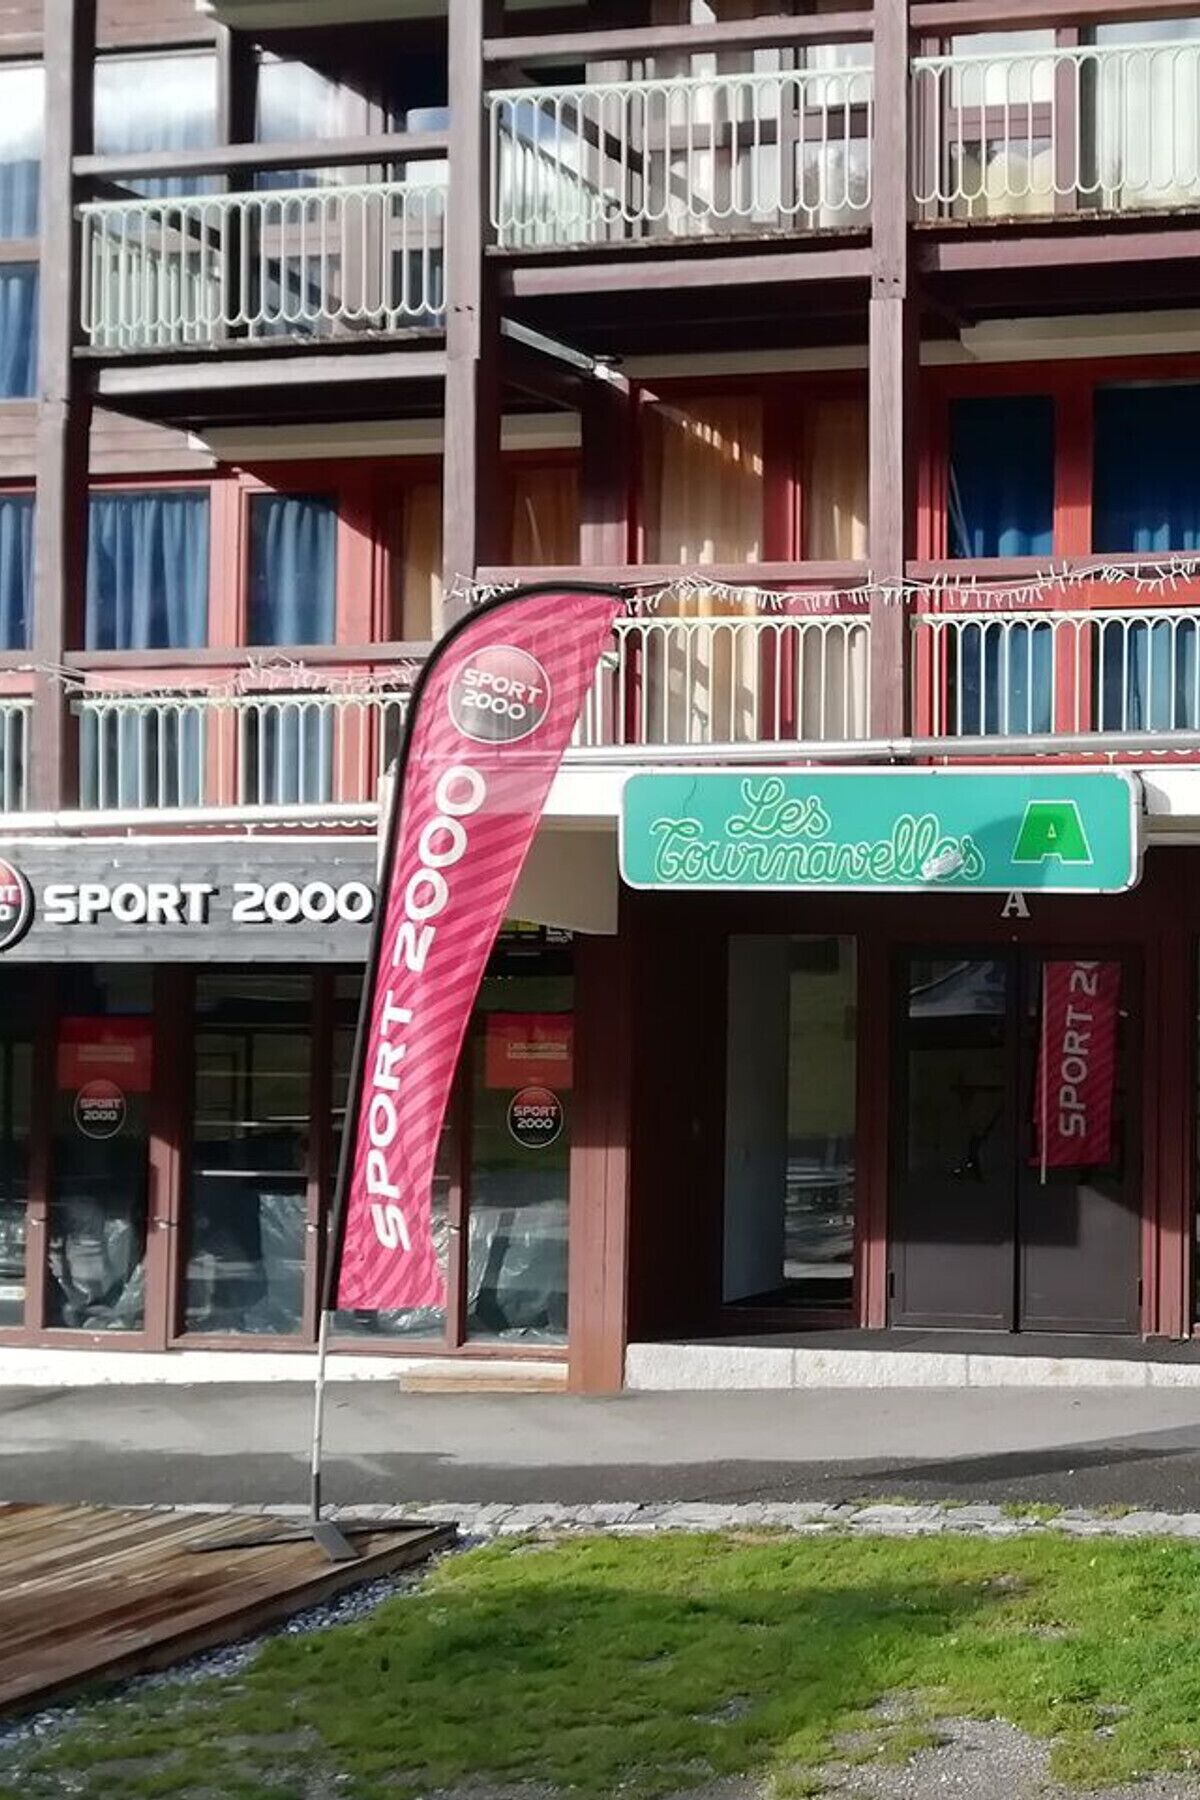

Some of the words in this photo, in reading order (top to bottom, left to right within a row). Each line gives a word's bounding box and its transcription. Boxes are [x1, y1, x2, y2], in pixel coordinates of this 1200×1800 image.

[461, 667, 543, 704] SPORT
[459, 689, 526, 720] 2000
[725, 777, 831, 838] Les
[1011, 800, 1094, 864] A
[43, 882, 215, 923] SPORT
[232, 881, 374, 922] 2000
[1001, 890, 1031, 918] A
[366, 990, 413, 1251] SPORT
[391, 765, 487, 973] 2000
[1059, 1004, 1093, 1137] SPORT
[80, 1098, 121, 1109] SPORT
[83, 1110, 118, 1121] 2000
[513, 1106, 558, 1117] SPORT
[517, 1117, 554, 1130] 2000
